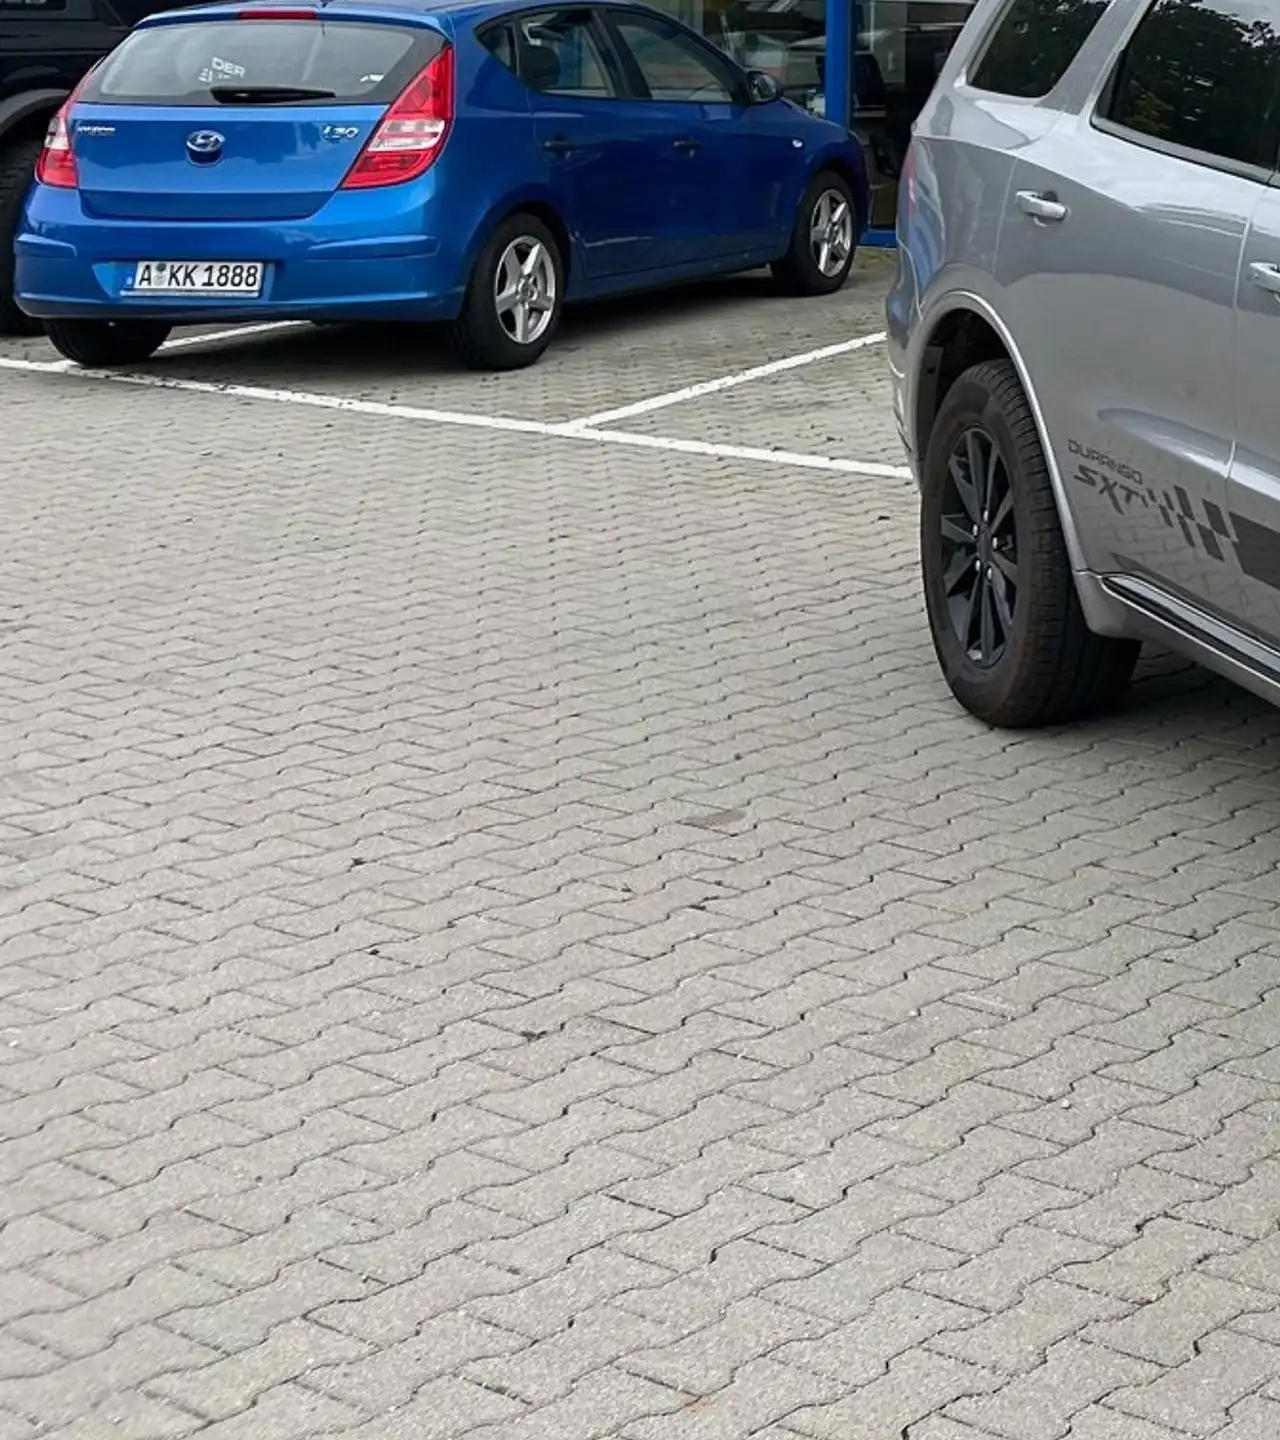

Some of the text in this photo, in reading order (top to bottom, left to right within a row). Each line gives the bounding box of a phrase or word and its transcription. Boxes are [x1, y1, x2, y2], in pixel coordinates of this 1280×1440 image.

[139, 264, 259, 287] A KK 1888
[1068, 438, 1143, 486] DURANGO
